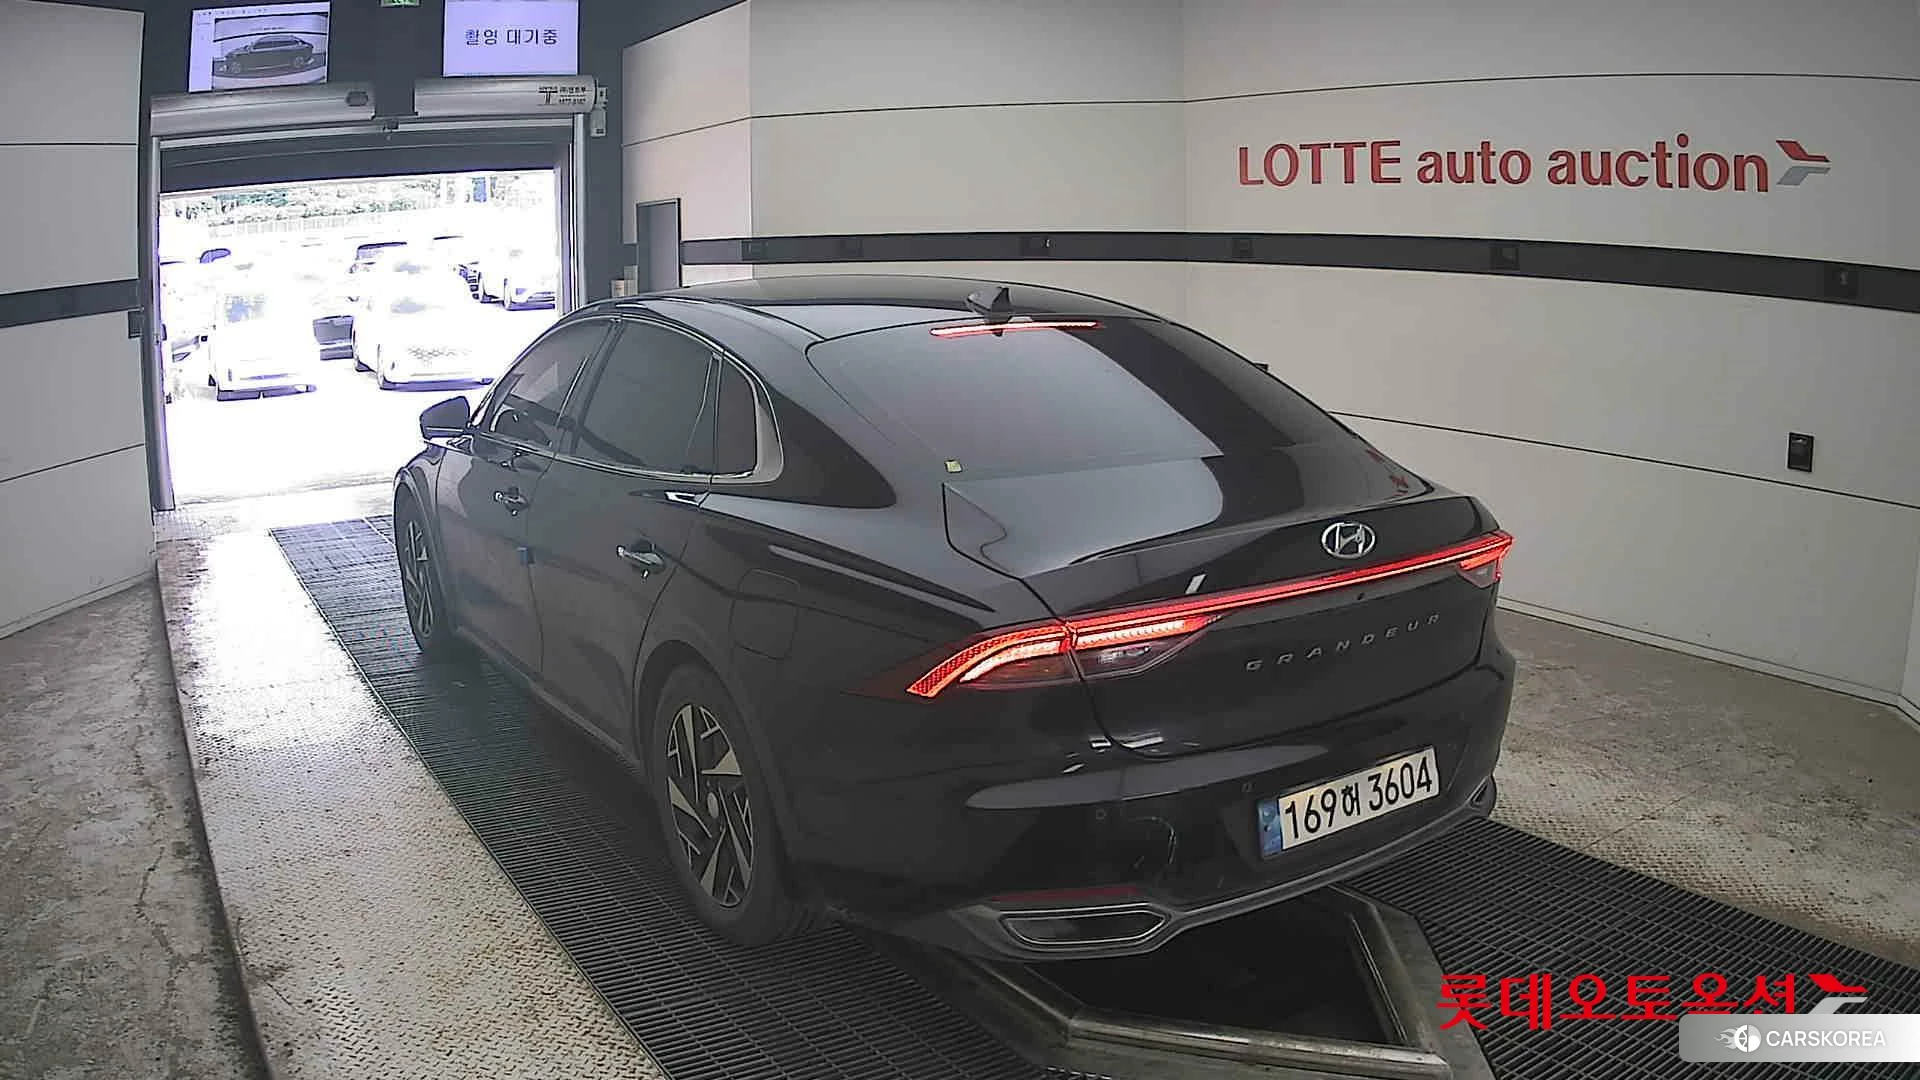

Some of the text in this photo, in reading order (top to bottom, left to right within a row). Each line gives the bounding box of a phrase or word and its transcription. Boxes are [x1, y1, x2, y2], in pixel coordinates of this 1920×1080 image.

[505, 28, 558, 46] 대기중
[1239, 133, 1769, 192] LOTTE auto auction
[1244, 612, 1441, 672] GRANDEUR
[1283, 756, 1434, 841] 169허 3604
